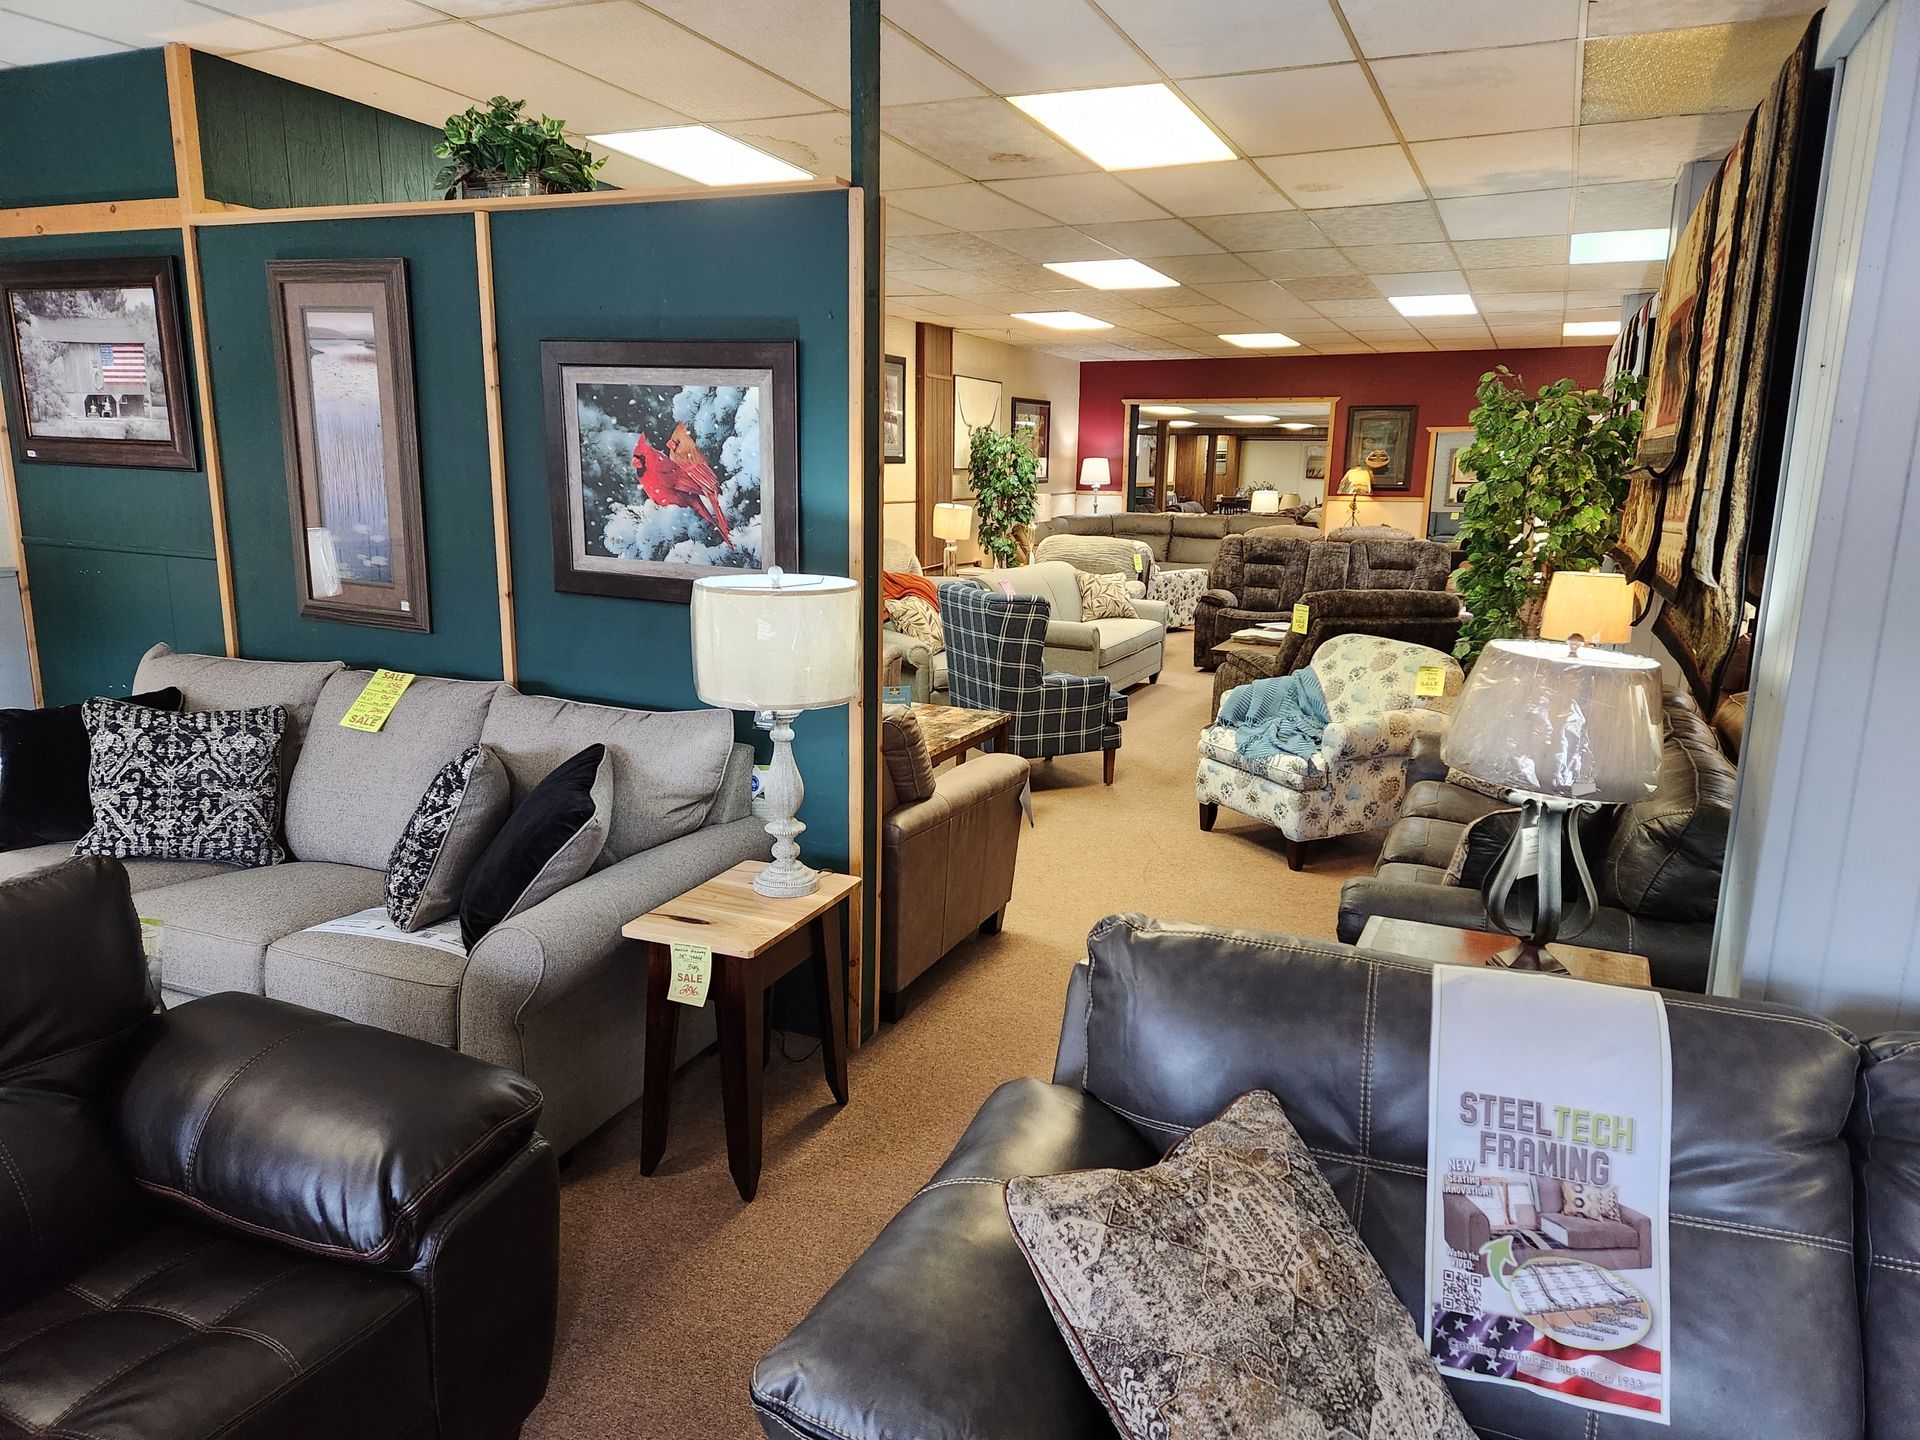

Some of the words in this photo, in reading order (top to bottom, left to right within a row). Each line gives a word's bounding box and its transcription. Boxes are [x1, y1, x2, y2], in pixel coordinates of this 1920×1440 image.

[382, 672, 406, 682] SALE
[349, 715, 379, 727] SALE
[677, 972, 703, 984] SALE
[1448, 1158, 1475, 1172] NEW
[1479, 1130, 1610, 1187] FRAMING
[1447, 1172, 1480, 1186] Seating
[1448, 1337, 1497, 1359] Creating
[1499, 1348, 1551, 1369] American
[1555, 1362, 1577, 1375] Jobs
[1580, 1367, 1612, 1382] Since
[1617, 1374, 1643, 1389] 1933
